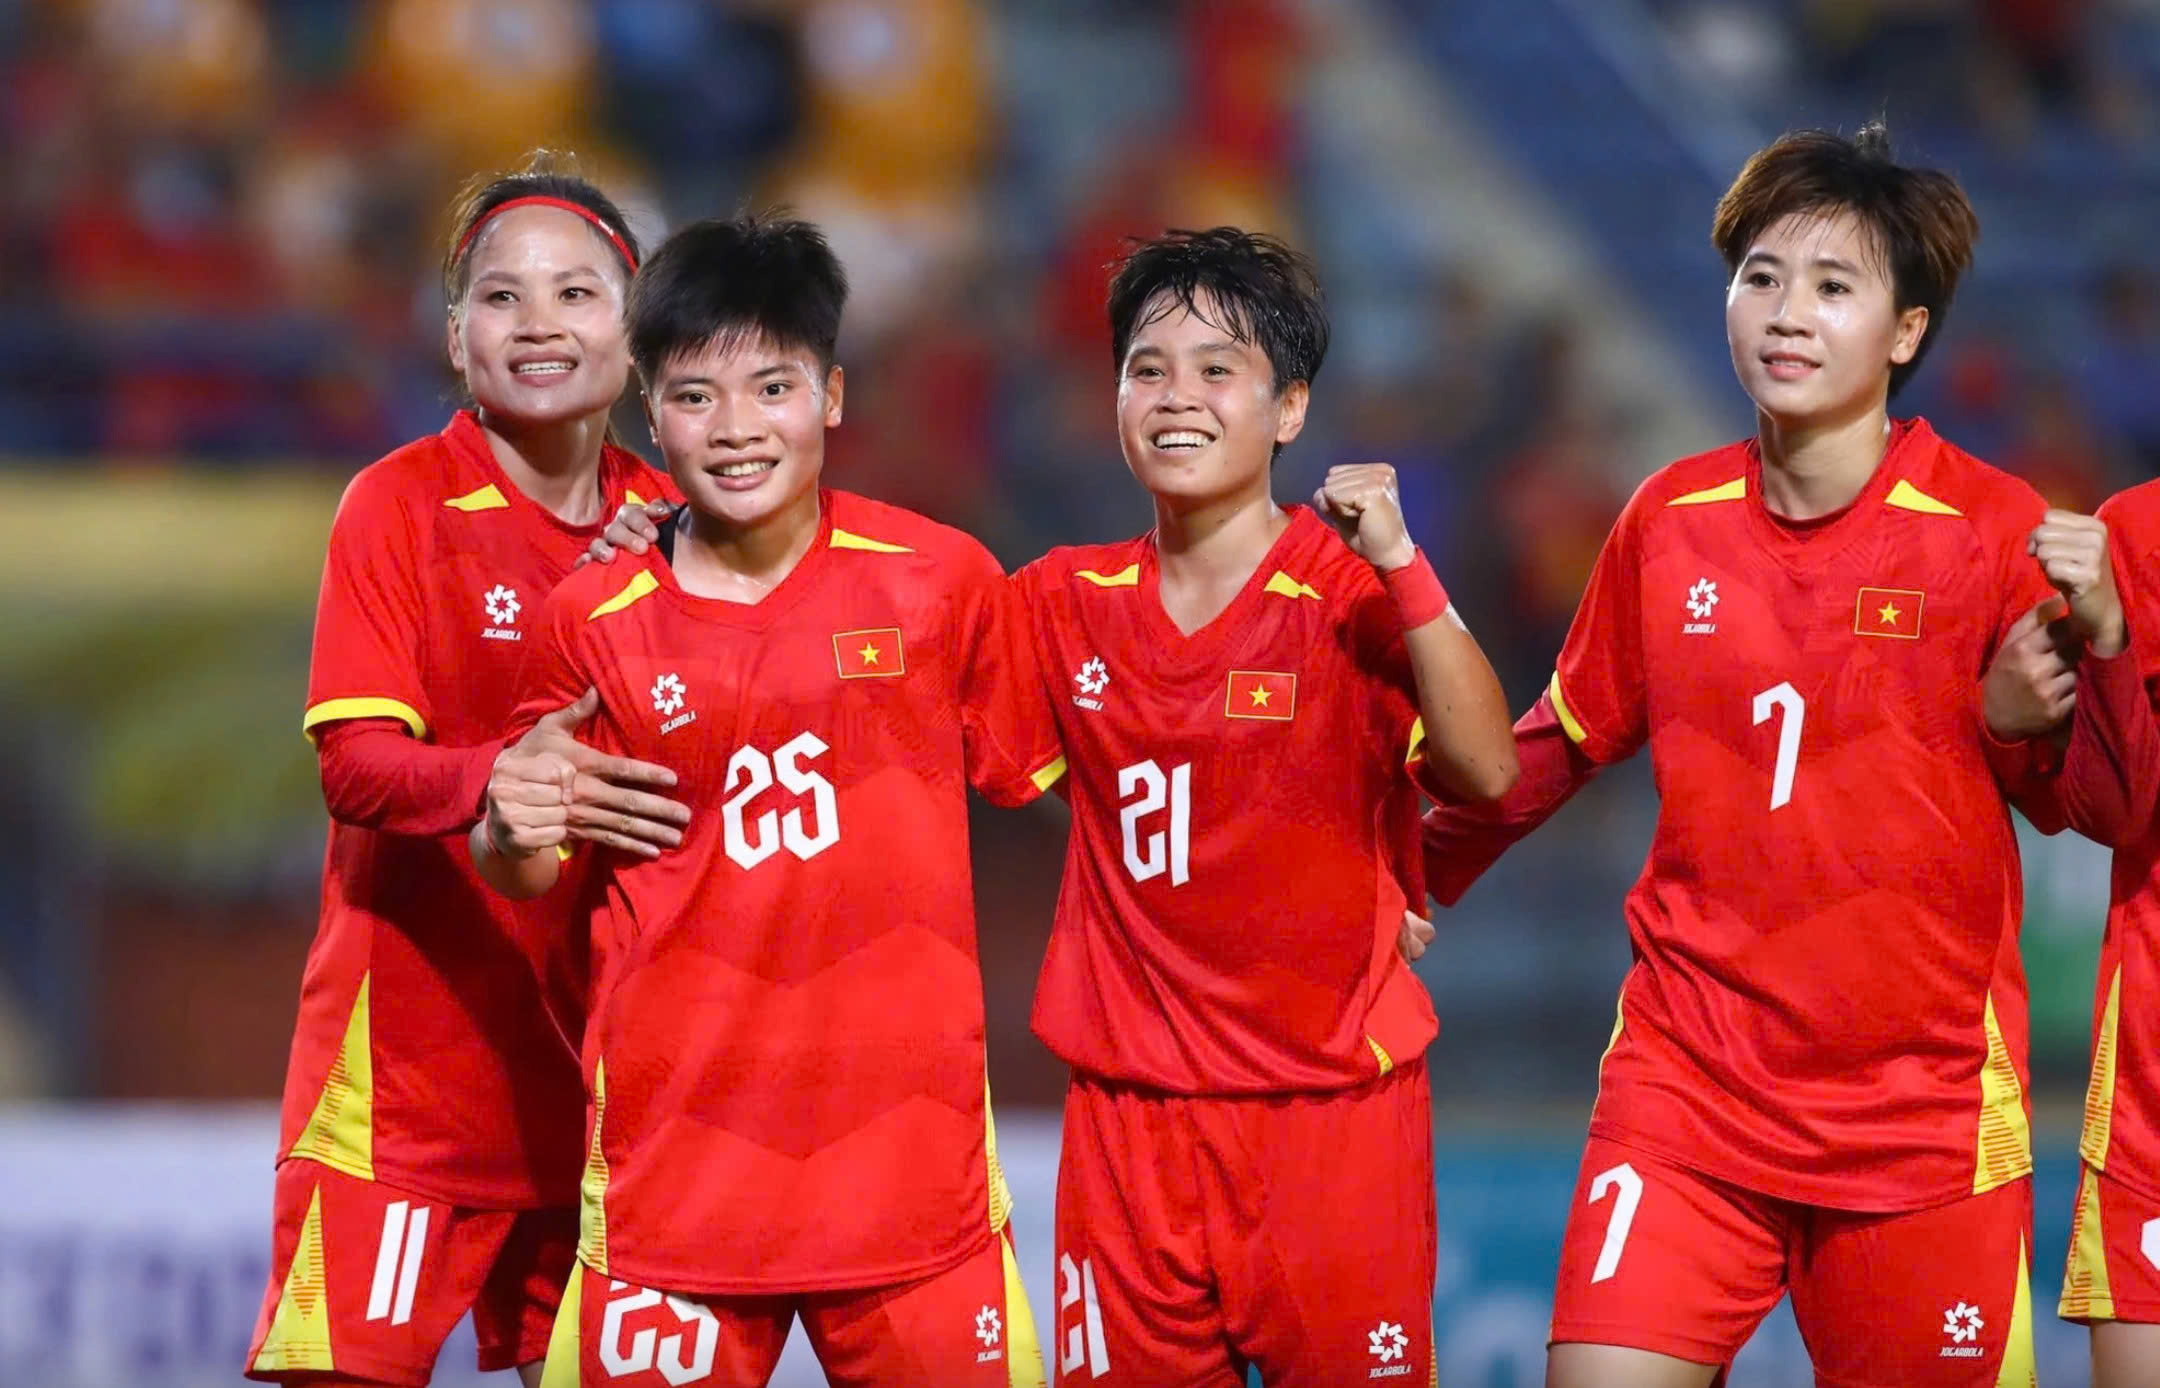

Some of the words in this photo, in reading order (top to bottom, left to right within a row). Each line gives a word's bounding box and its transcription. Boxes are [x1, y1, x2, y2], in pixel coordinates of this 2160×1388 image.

[721, 730, 840, 871] 25
[1752, 681, 1805, 810] 7
[1117, 758, 1191, 888] 21
[366, 1200, 430, 1326] 11
[1588, 1162, 1644, 1285] 7
[598, 1279, 720, 1387] 25
[1060, 1252, 1111, 1380] 21
